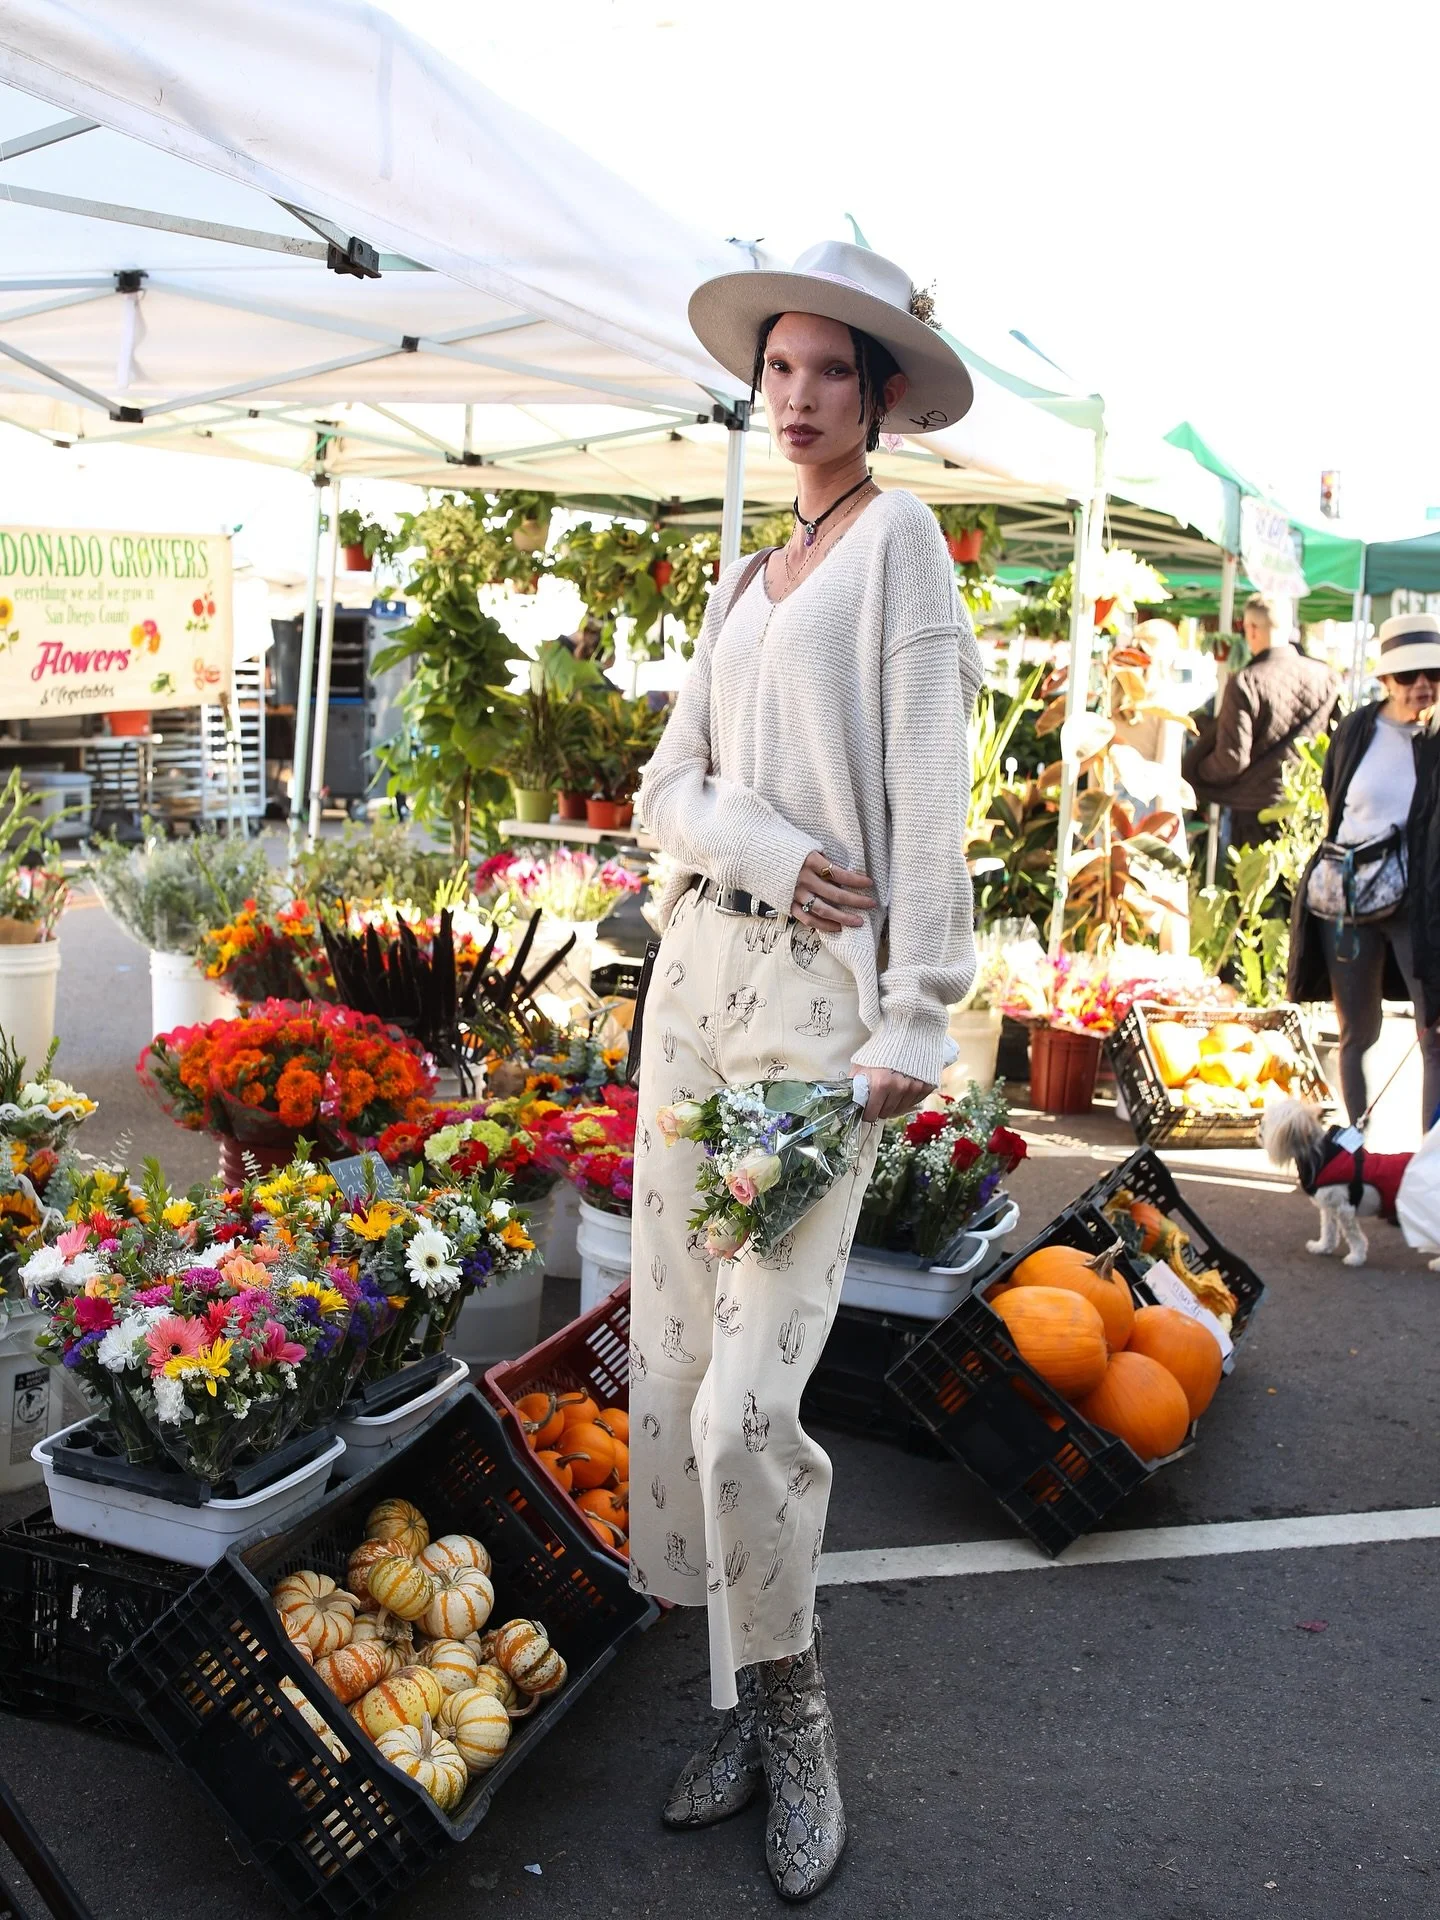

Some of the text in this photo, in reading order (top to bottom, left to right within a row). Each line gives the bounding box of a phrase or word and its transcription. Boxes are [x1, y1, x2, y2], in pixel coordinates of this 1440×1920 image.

[0, 532, 209, 579] DONADO GROWERS
[14, 581, 66, 603] everything
[45, 603, 130, 626] San Diego County
[31, 641, 131, 681] Flowers
[51, 684, 115, 704] Vegetables
